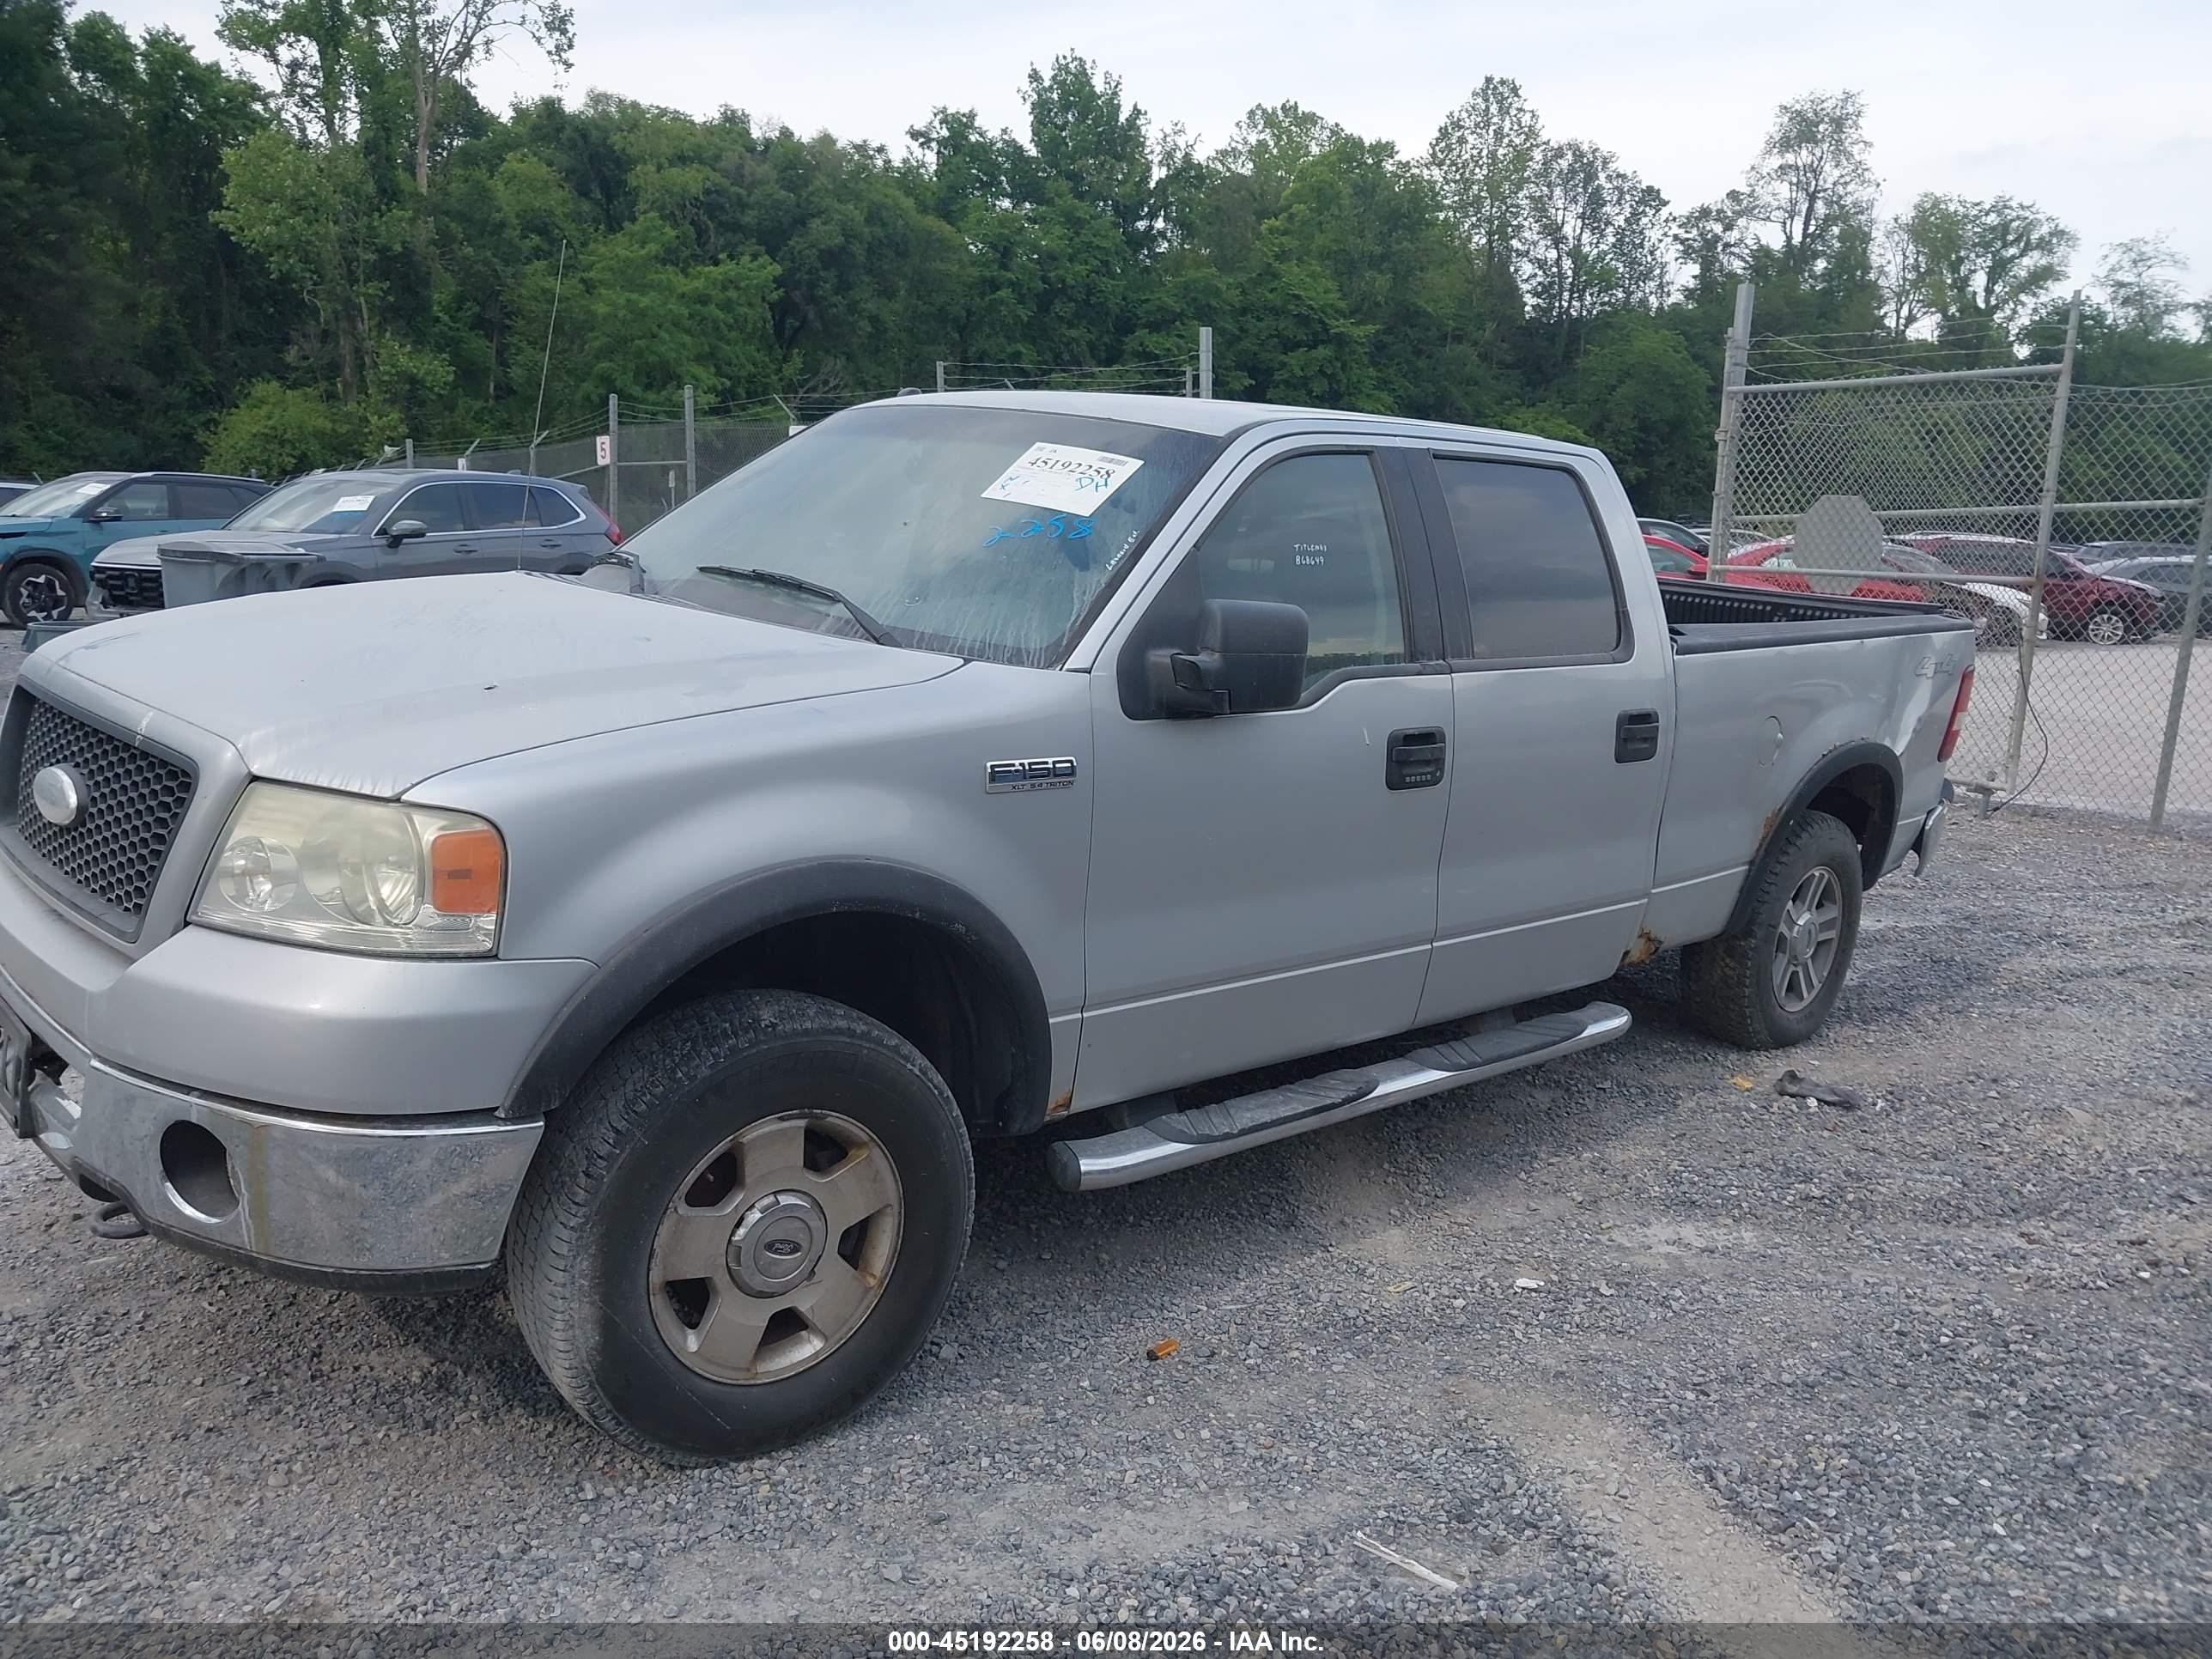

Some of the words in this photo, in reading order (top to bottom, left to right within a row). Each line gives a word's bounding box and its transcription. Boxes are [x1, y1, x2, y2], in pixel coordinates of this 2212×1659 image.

[599, 441, 607, 460] 5
[1027, 455, 1116, 480] 45192258
[982, 513, 1097, 548] 2258
[1045, 779, 1075, 789] TRITON
